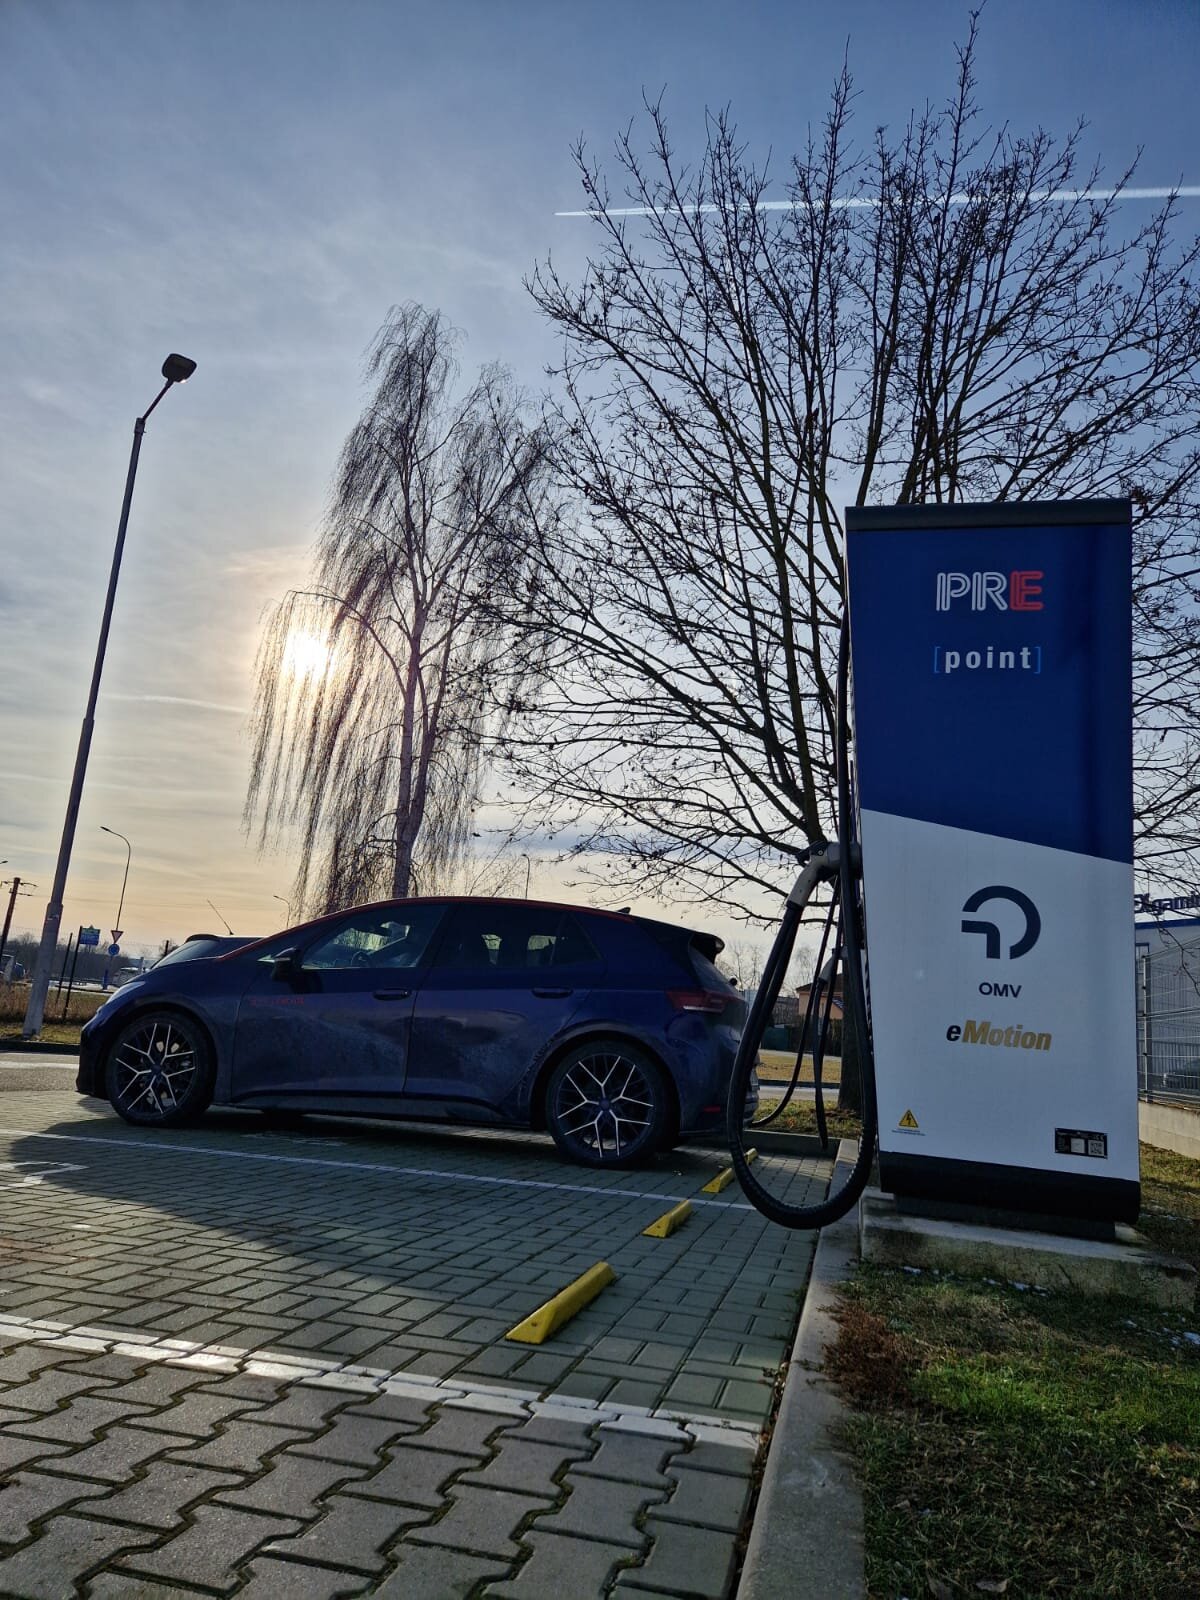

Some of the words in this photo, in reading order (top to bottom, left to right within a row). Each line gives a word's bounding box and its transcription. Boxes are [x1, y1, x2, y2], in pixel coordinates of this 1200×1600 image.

[935, 570, 1044, 612] PRE
[978, 981, 1023, 999] OMV
[945, 1019, 1053, 1052] eMotion
